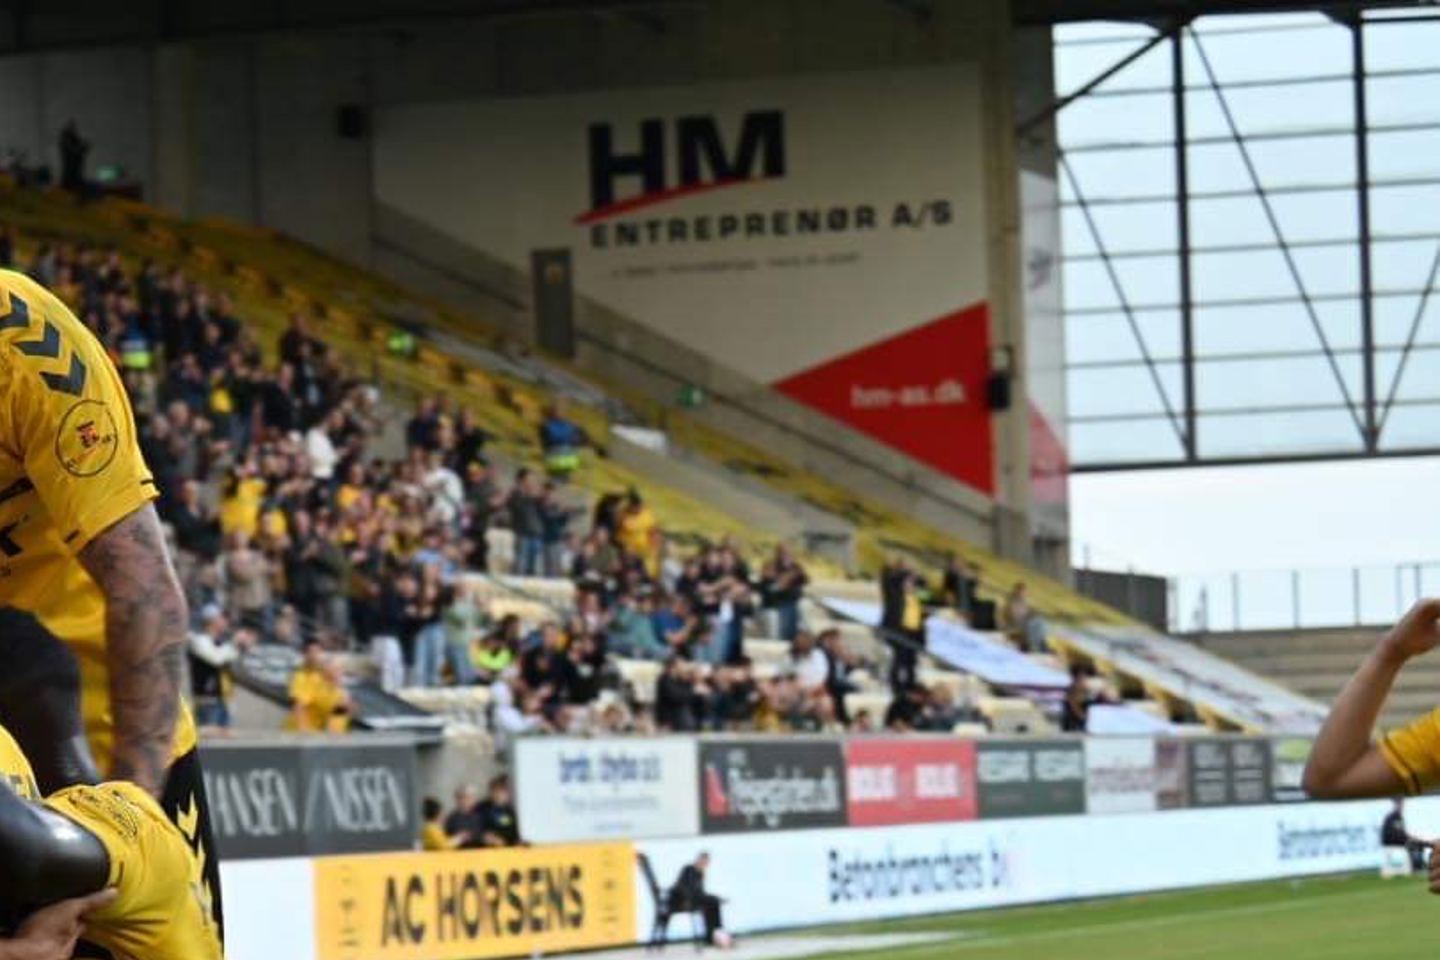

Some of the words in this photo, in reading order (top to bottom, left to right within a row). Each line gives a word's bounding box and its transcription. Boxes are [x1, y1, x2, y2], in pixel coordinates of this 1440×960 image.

[588, 110, 786, 211] HM
[591, 204, 877, 249] ENTREPRENØR
[891, 198, 953, 230] A/S
[381, 874, 426, 947] AC
[436, 864, 584, 939] HORSENS
